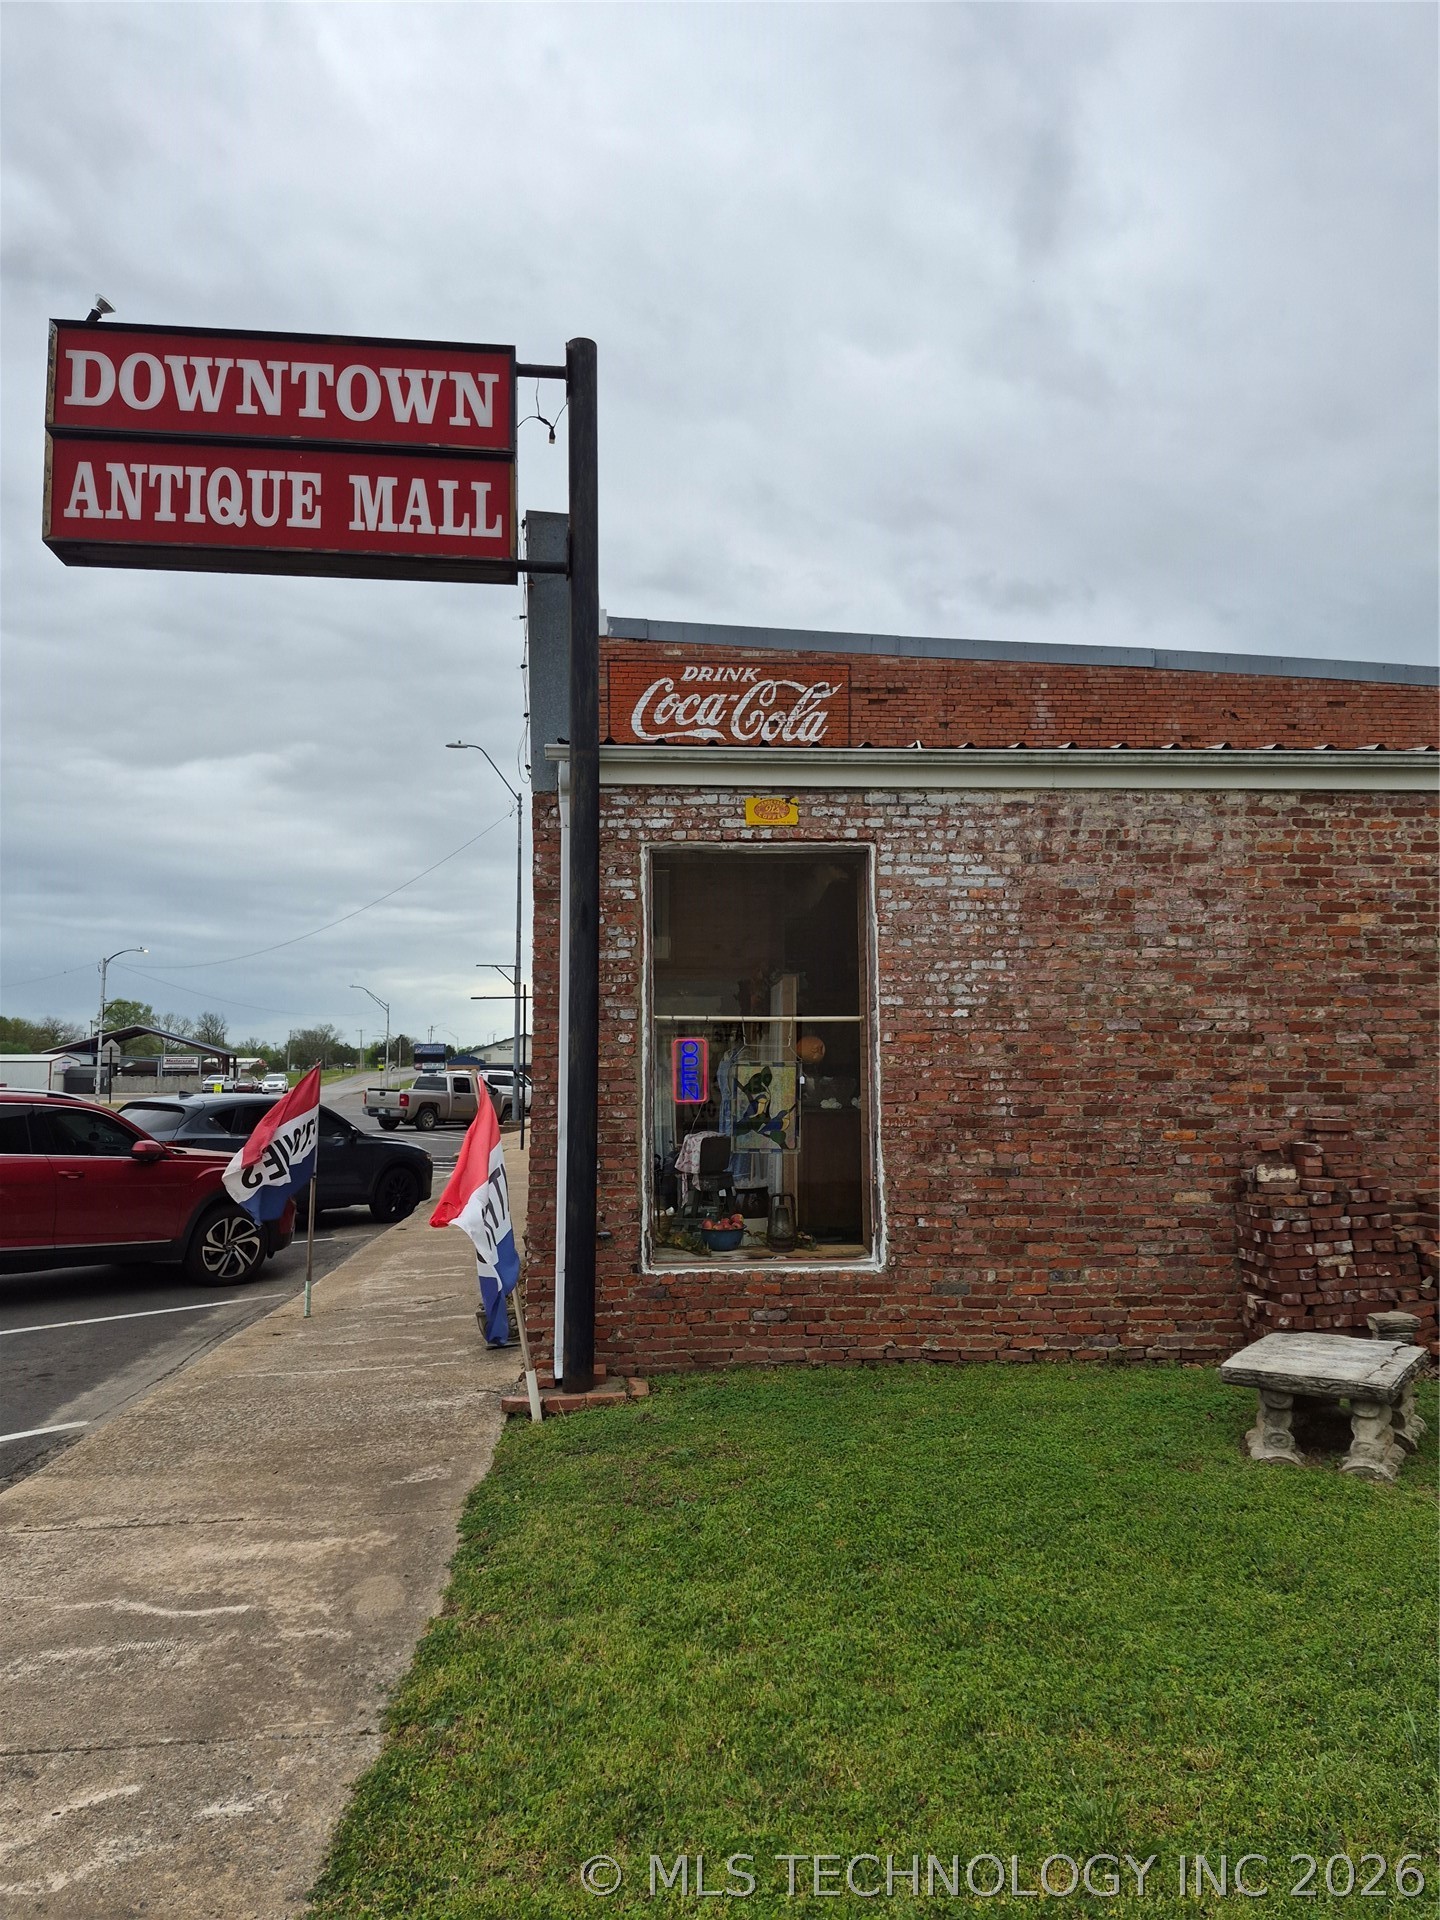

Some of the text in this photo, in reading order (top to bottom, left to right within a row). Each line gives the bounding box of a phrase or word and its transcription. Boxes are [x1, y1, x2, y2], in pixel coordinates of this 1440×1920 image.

[63, 348, 499, 428] DOWNTOWN
[63, 461, 503, 539] ANTIQUE MALL
[681, 666, 760, 682] DRINK
[630, 677, 842, 741] Coca-Cola
[681, 1040, 699, 1101] OPEN
